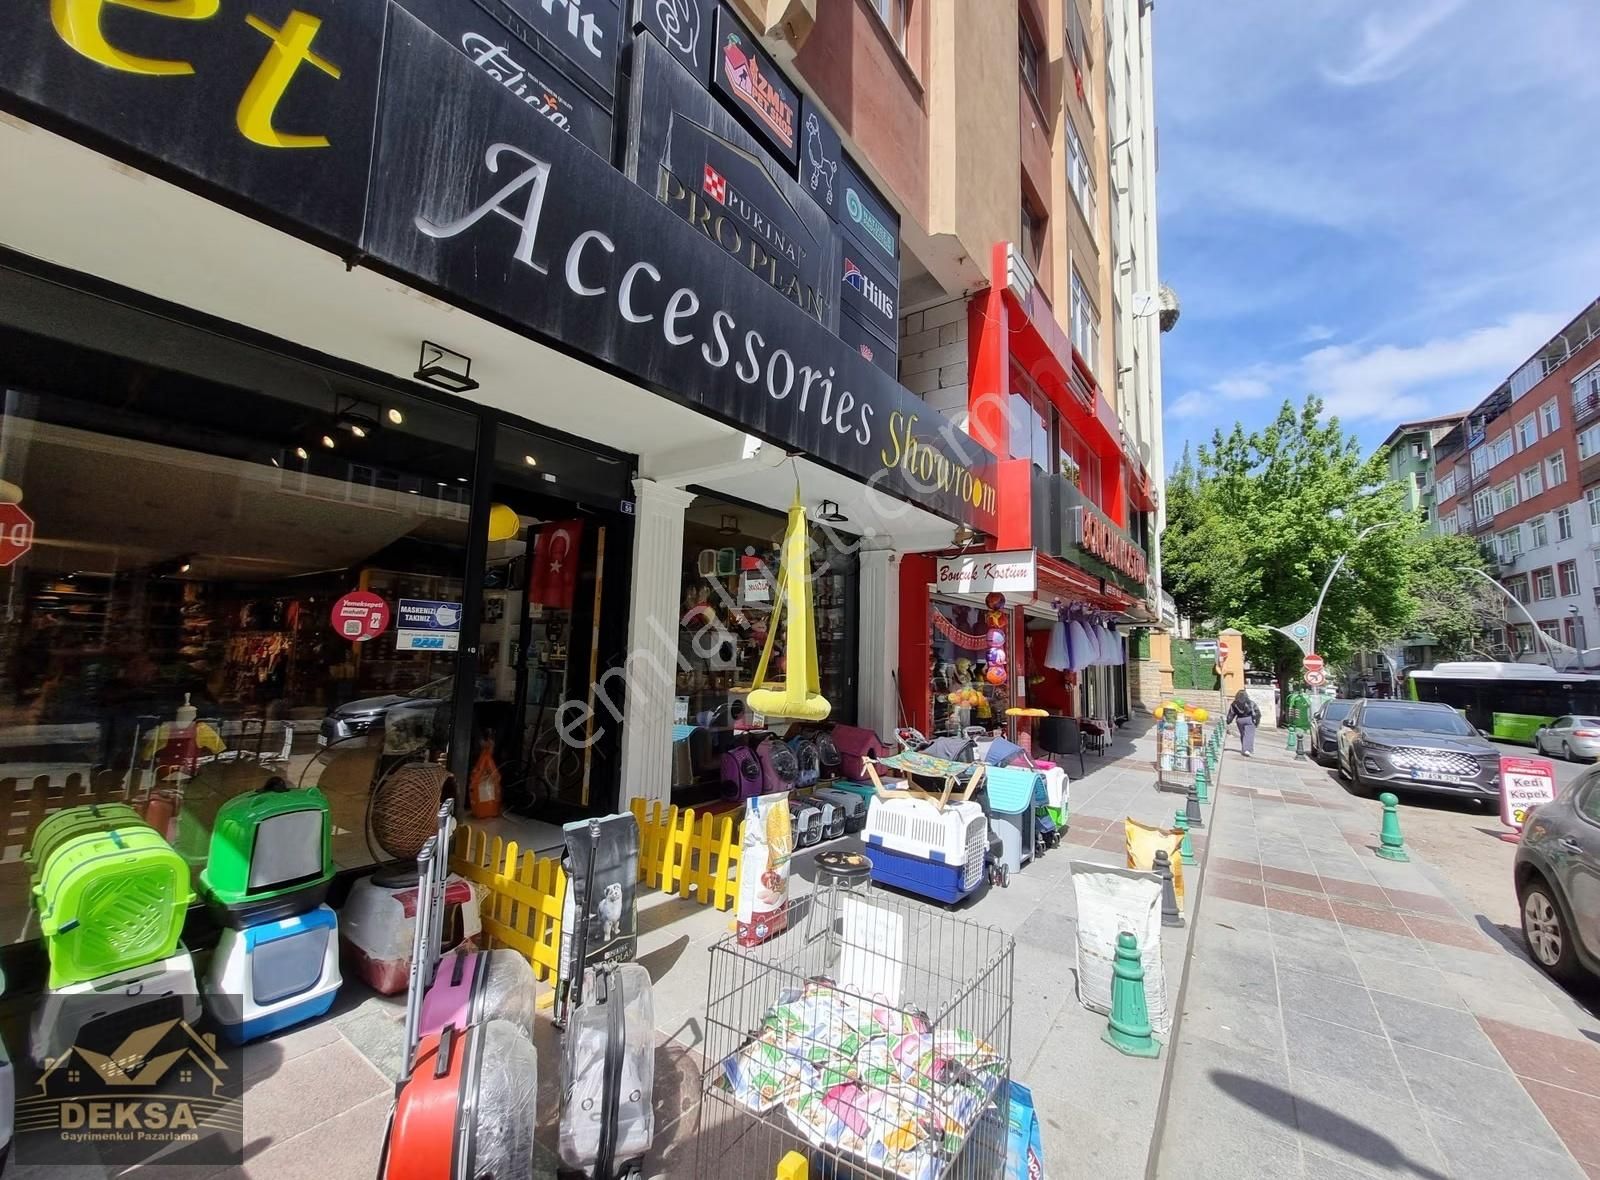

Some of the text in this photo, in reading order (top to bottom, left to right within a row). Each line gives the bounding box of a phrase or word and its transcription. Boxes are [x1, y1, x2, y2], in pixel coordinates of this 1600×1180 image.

[770, 109, 793, 137] SHOP
[657, 163, 825, 322] PRO PLAN
[728, 191, 797, 261] PURINA
[414, 142, 874, 446] Accessories
[862, 276, 894, 320] Hill's
[881, 410, 997, 517] Showroom
[939, 562, 1027, 582] Boncuk Kostüm
[343, 599, 384, 609] Yemeksepeti
[1512, 777, 1544, 788] Kedi
